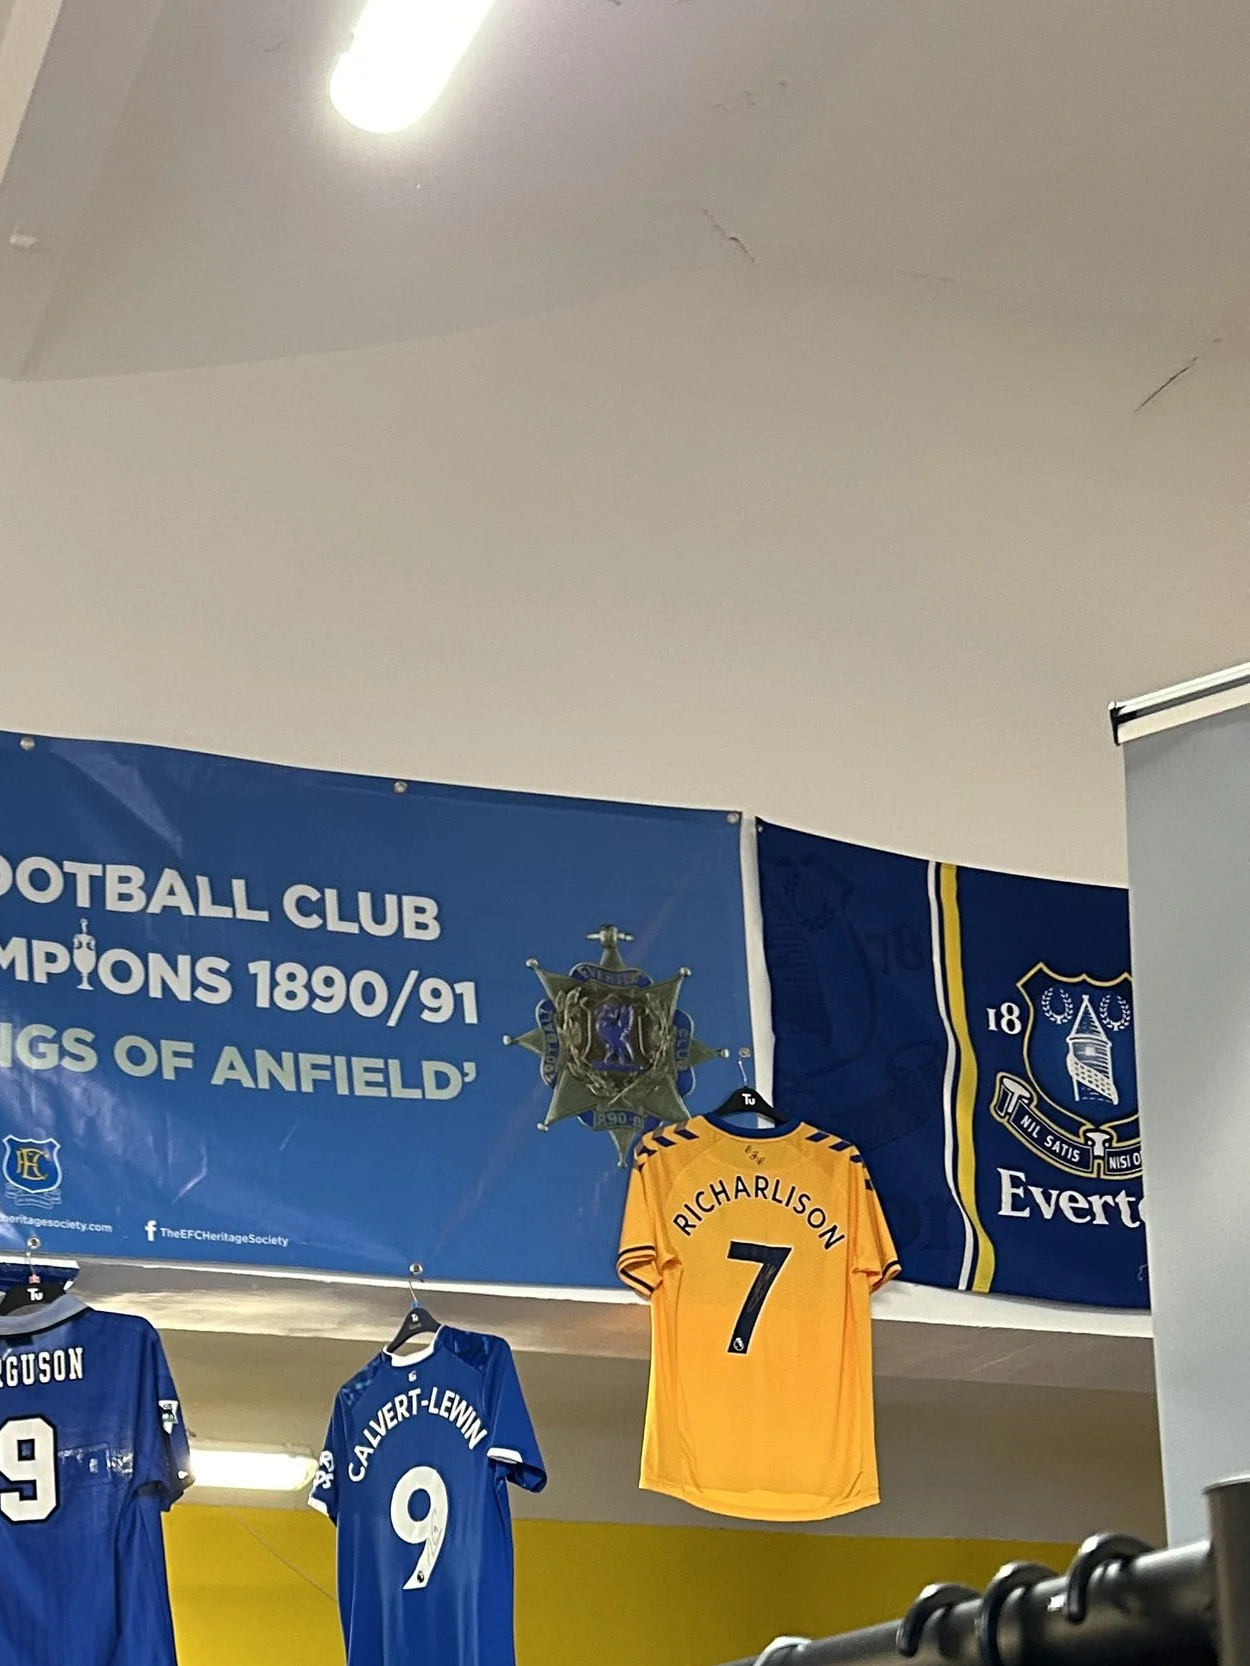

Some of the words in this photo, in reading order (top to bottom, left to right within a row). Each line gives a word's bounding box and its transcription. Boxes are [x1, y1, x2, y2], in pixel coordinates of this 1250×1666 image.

[282, 883, 442, 942] CLUB
[248, 960, 479, 1027] 1890/91
[986, 1002, 1022, 1035] 18
[113, 1035, 195, 1081] OF
[210, 1045, 478, 1101] ANFIELD’
[1019, 1114, 1041, 1140] NIL
[1044, 1135, 1081, 1163] SATIS
[1108, 1152, 1132, 1170] NISI
[672, 1175, 846, 1250] RICHARLISON
[997, 1167, 1147, 1229] Evert
[160, 1227, 289, 1247] TheEFCHeritageSociety
[726, 1240, 793, 1355] 7
[348, 1386, 488, 1482] CALVERT-LEWIN
[390, 1465, 448, 1590] 9
